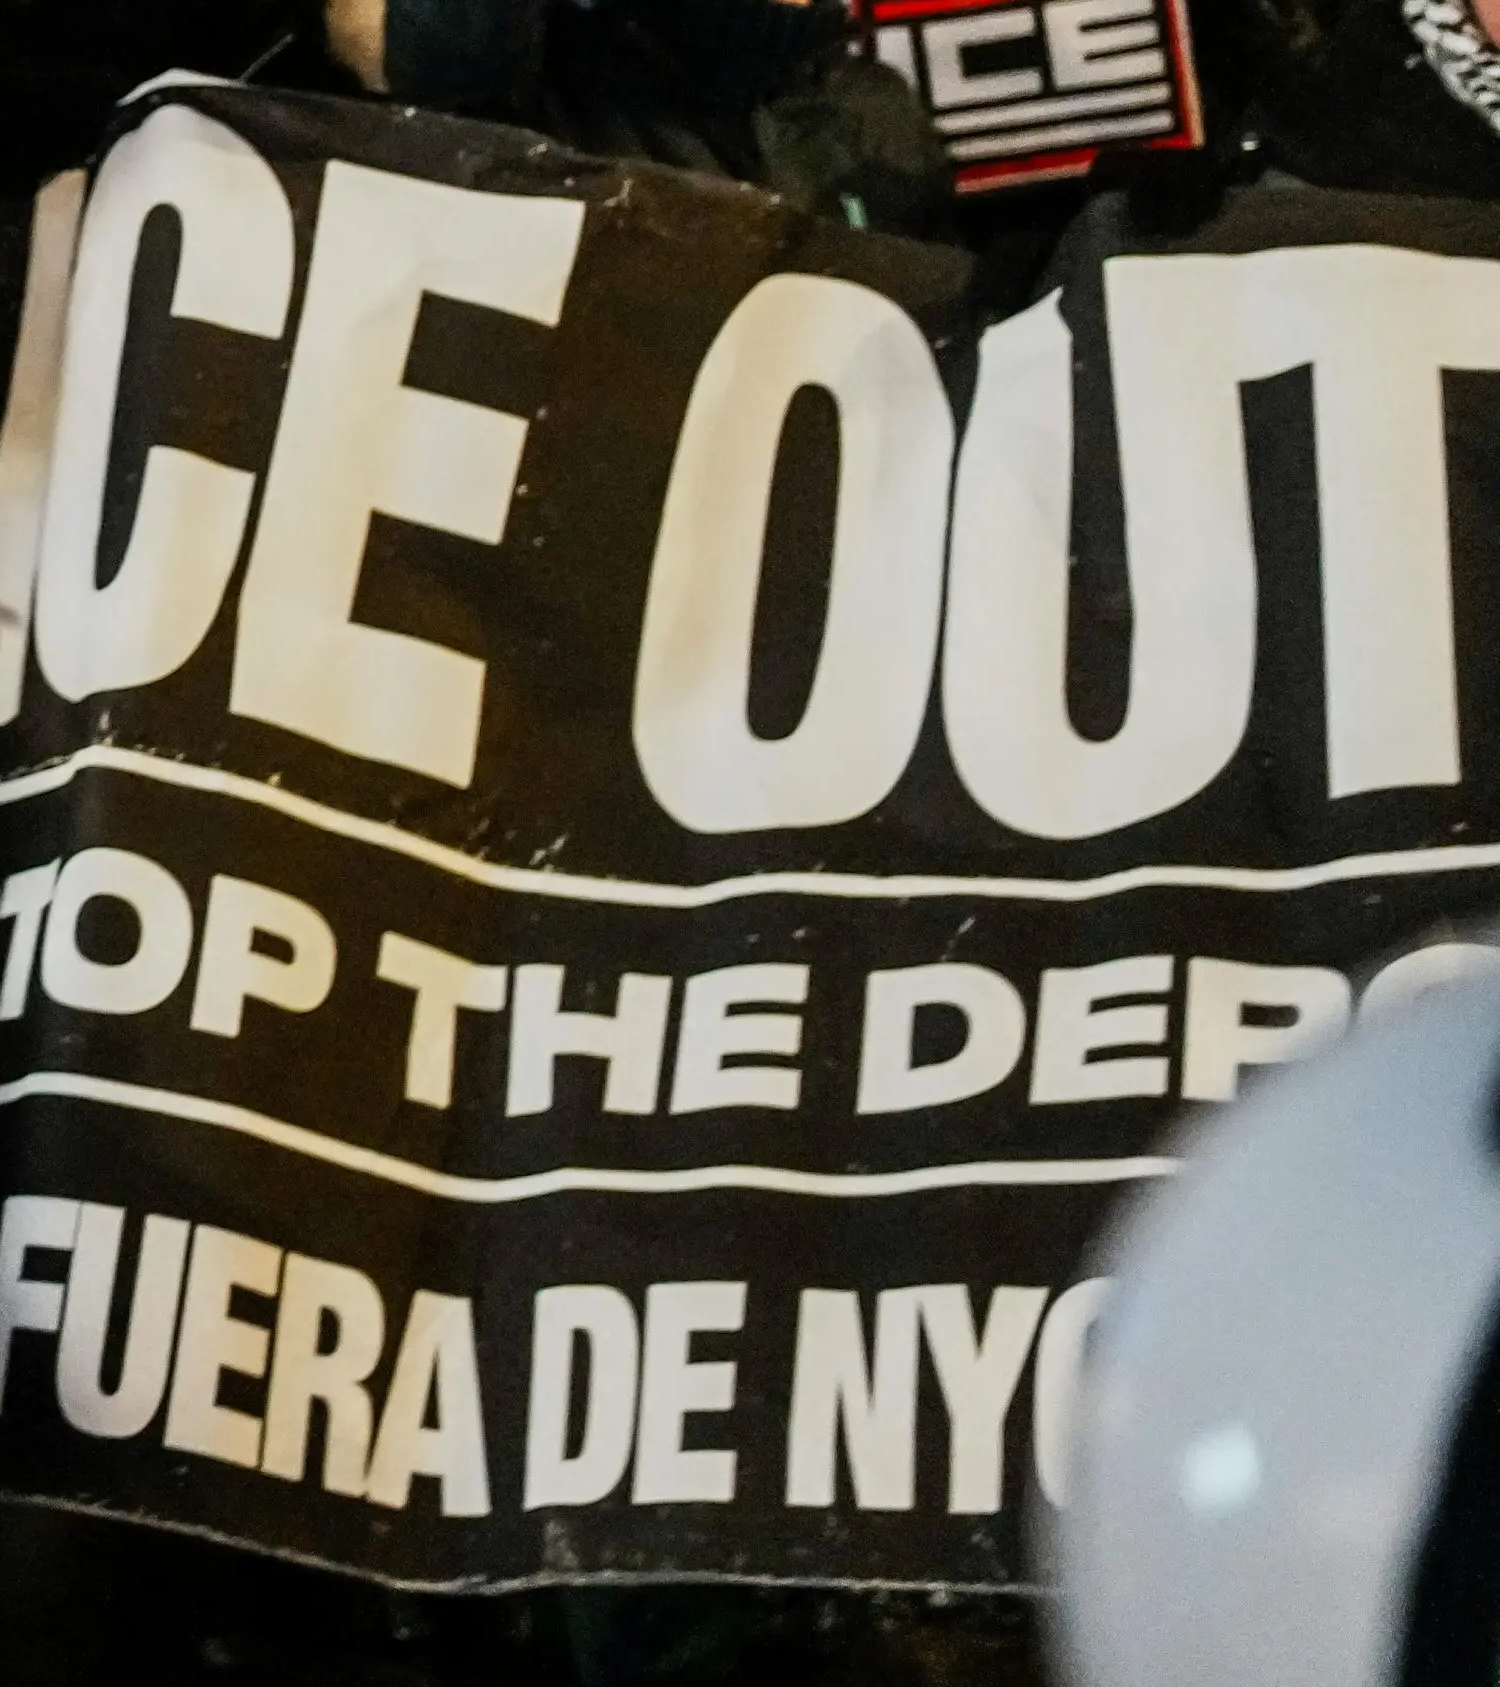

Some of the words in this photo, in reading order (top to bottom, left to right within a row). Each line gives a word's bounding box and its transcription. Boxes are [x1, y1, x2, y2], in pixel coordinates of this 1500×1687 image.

[632, 244, 1500, 839] OUT
[375, 929, 811, 1119] THE
[523, 1278, 743, 1511] DE
